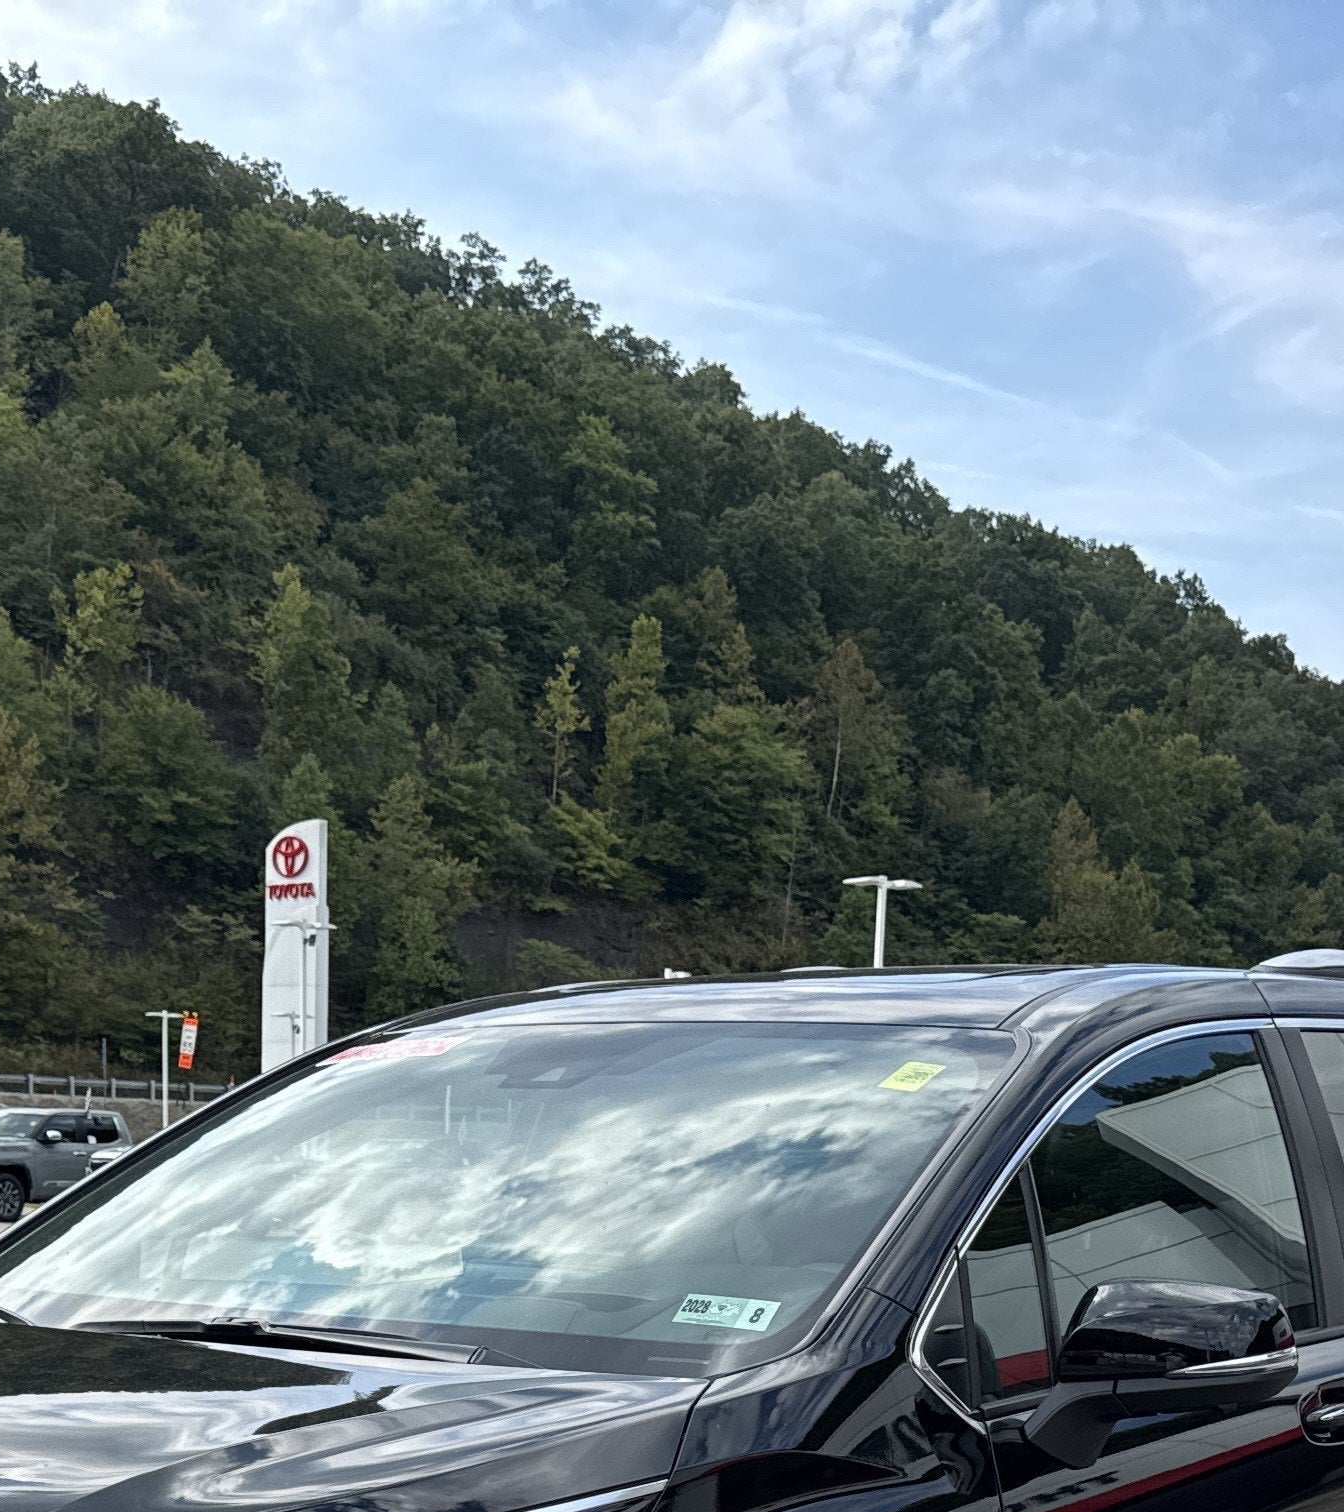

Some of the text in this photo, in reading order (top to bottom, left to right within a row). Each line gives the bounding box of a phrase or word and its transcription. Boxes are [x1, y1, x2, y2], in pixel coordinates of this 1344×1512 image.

[267, 882, 316, 901] TOYOTA
[681, 1299, 765, 1324] 2028 8
